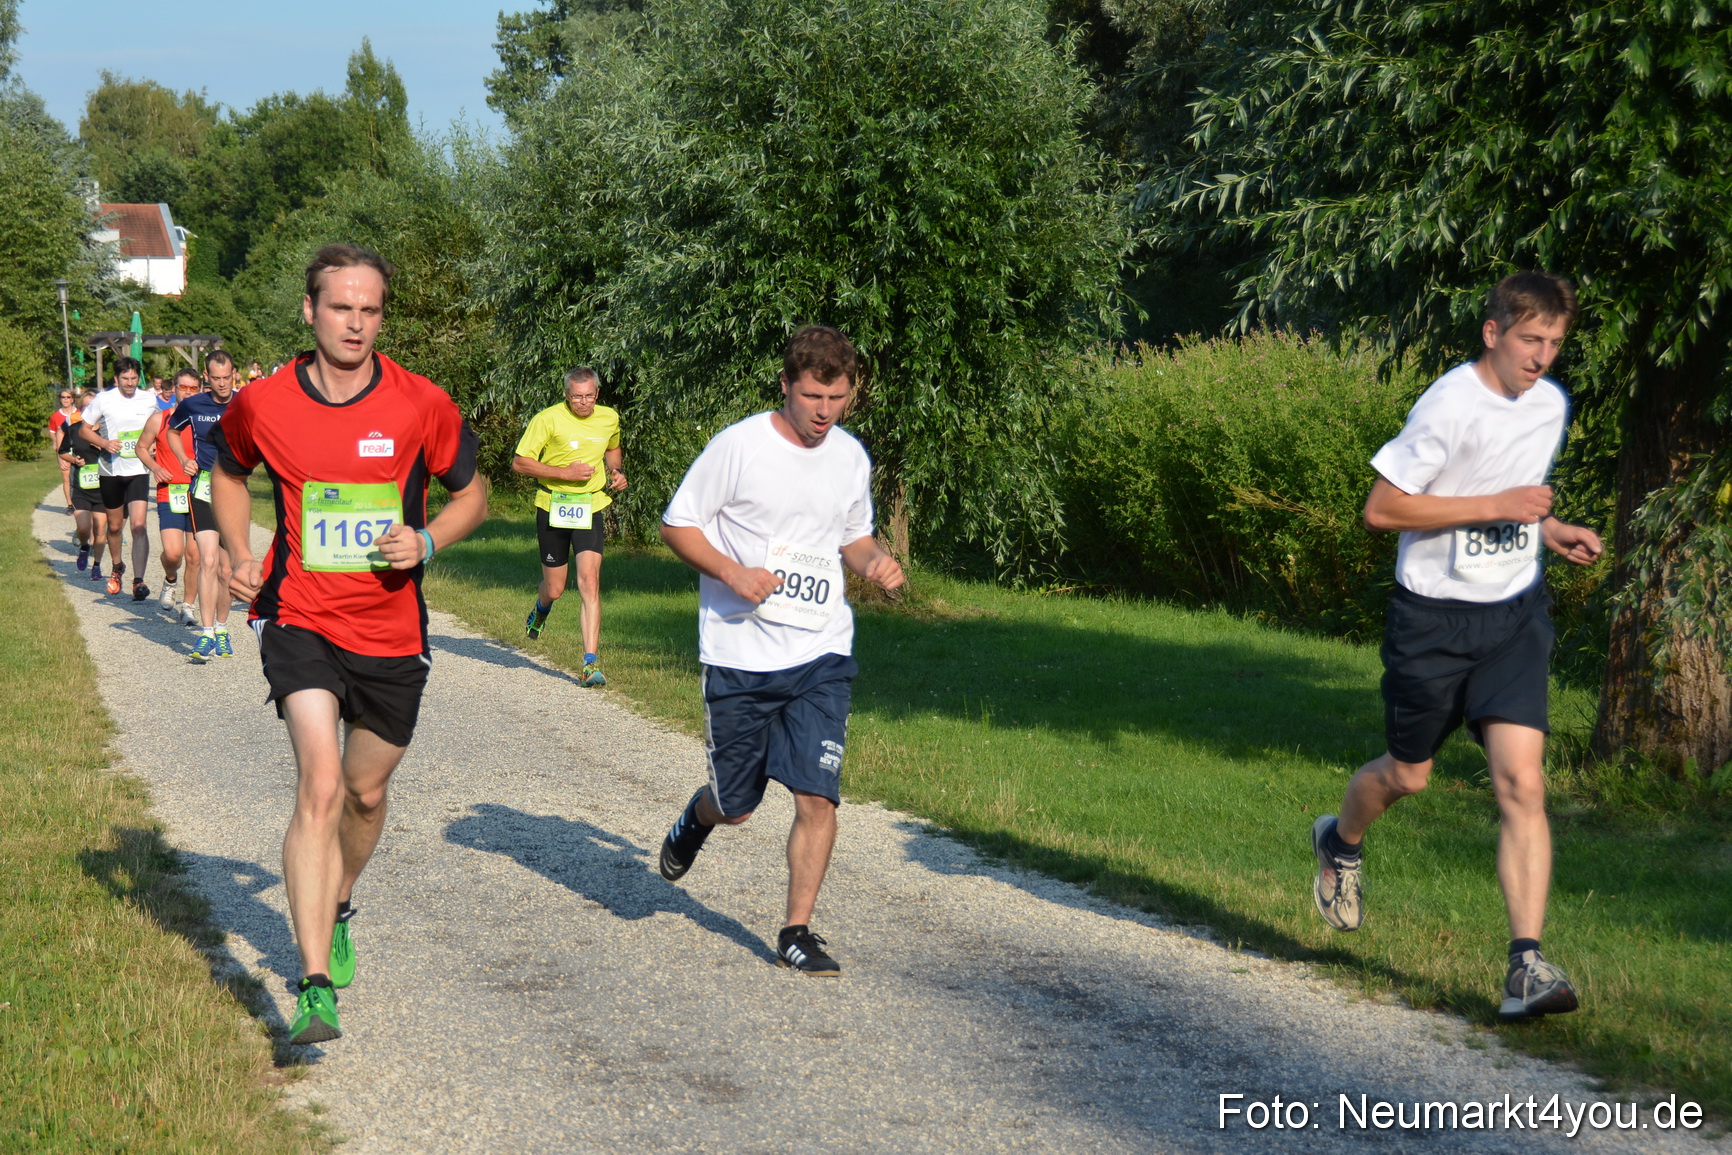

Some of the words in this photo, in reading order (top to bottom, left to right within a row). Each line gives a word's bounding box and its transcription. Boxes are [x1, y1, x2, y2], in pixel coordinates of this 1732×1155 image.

[559, 506, 583, 518] 640
[313, 519, 393, 547] 1167
[1464, 523, 1528, 557] 8936
